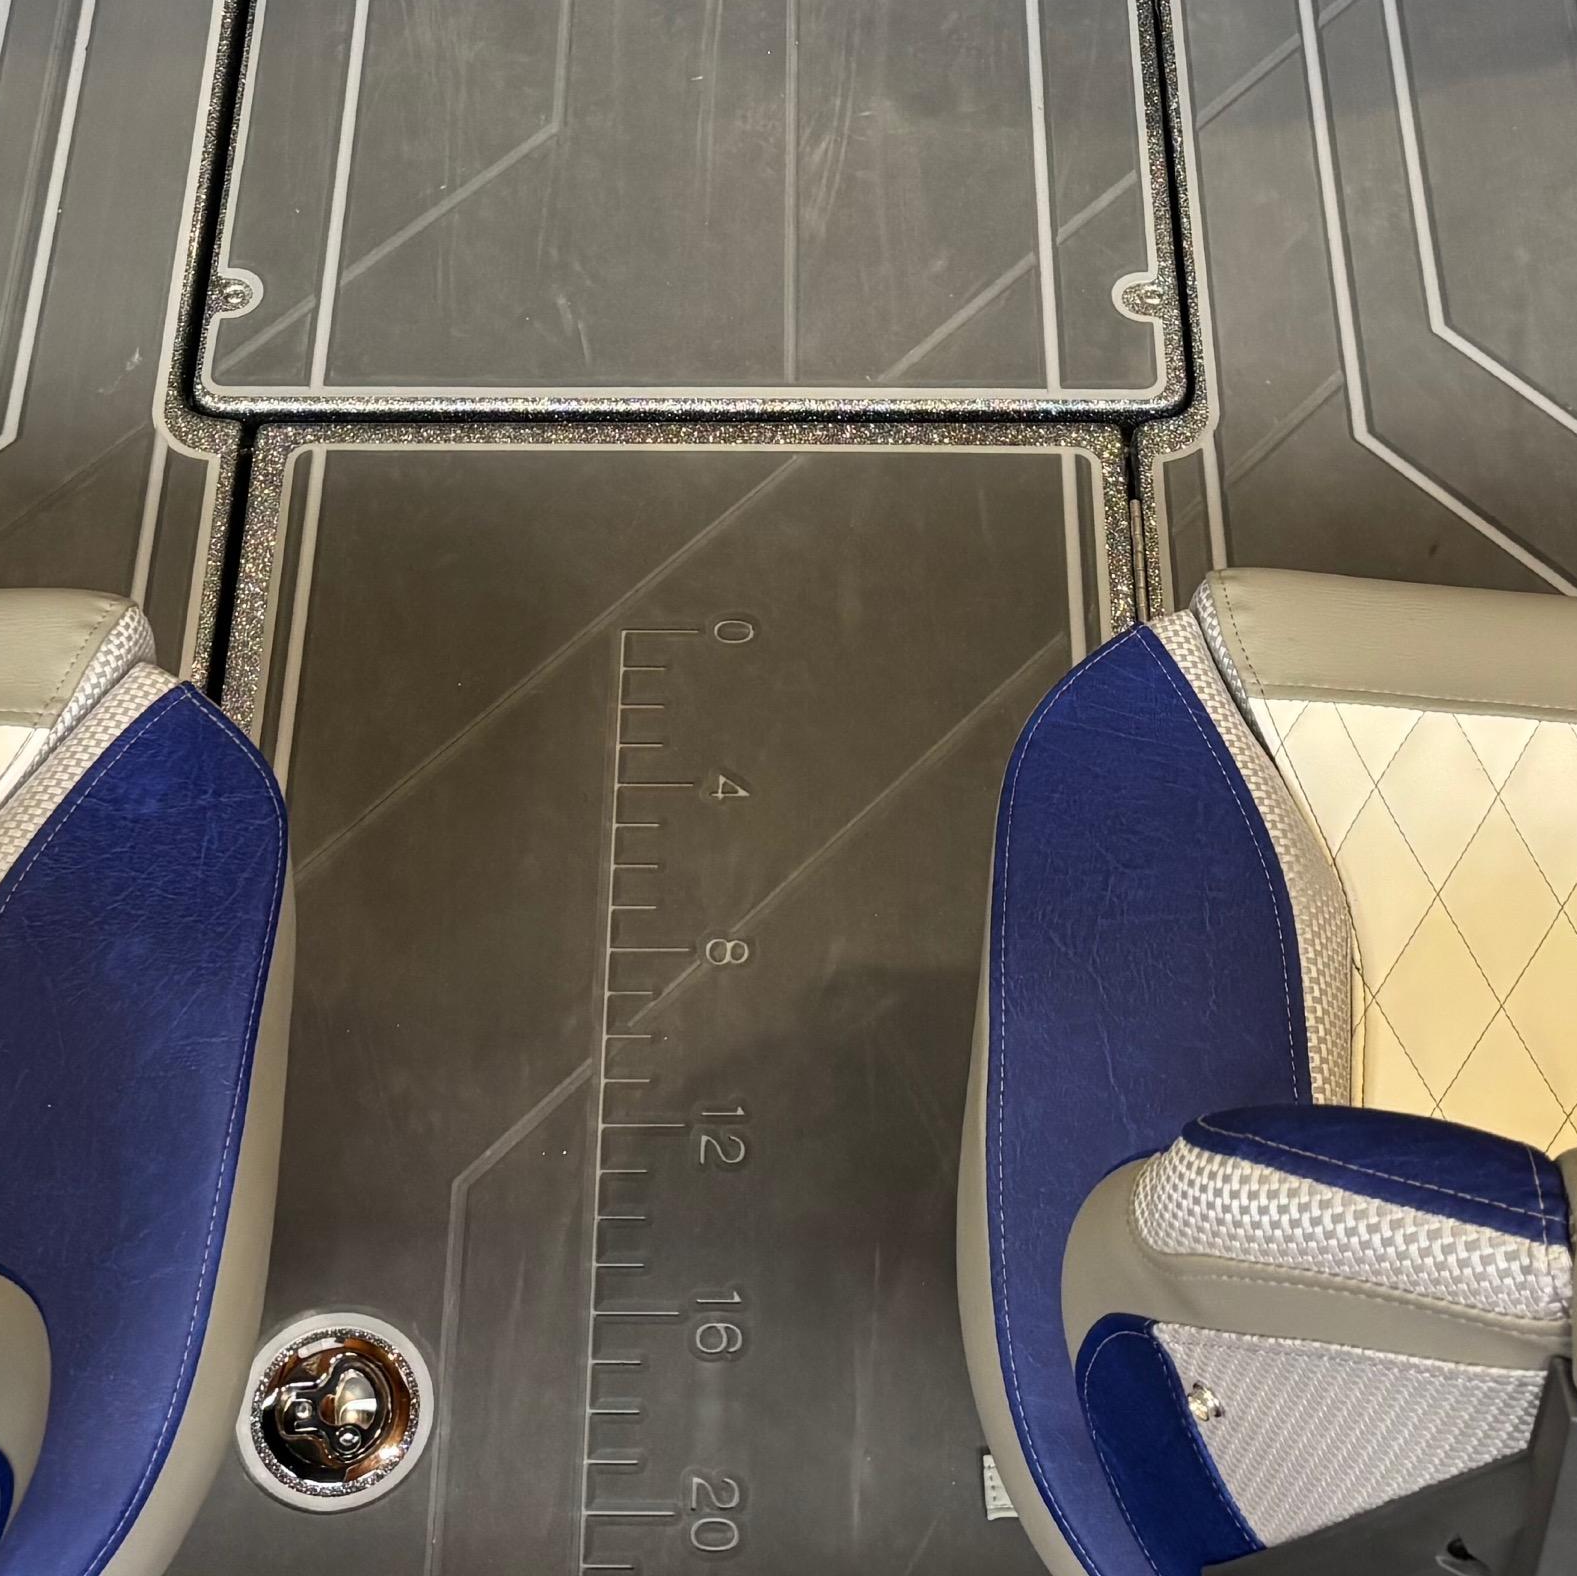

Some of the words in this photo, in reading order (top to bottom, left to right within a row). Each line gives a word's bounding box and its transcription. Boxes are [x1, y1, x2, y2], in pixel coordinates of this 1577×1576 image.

[714, 619, 755, 644] 0
[711, 773, 751, 801] 4
[705, 937, 749, 966] 8
[698, 1105, 746, 1166] 12
[694, 1289, 743, 1354] 16
[689, 1476, 740, 1551] 20
